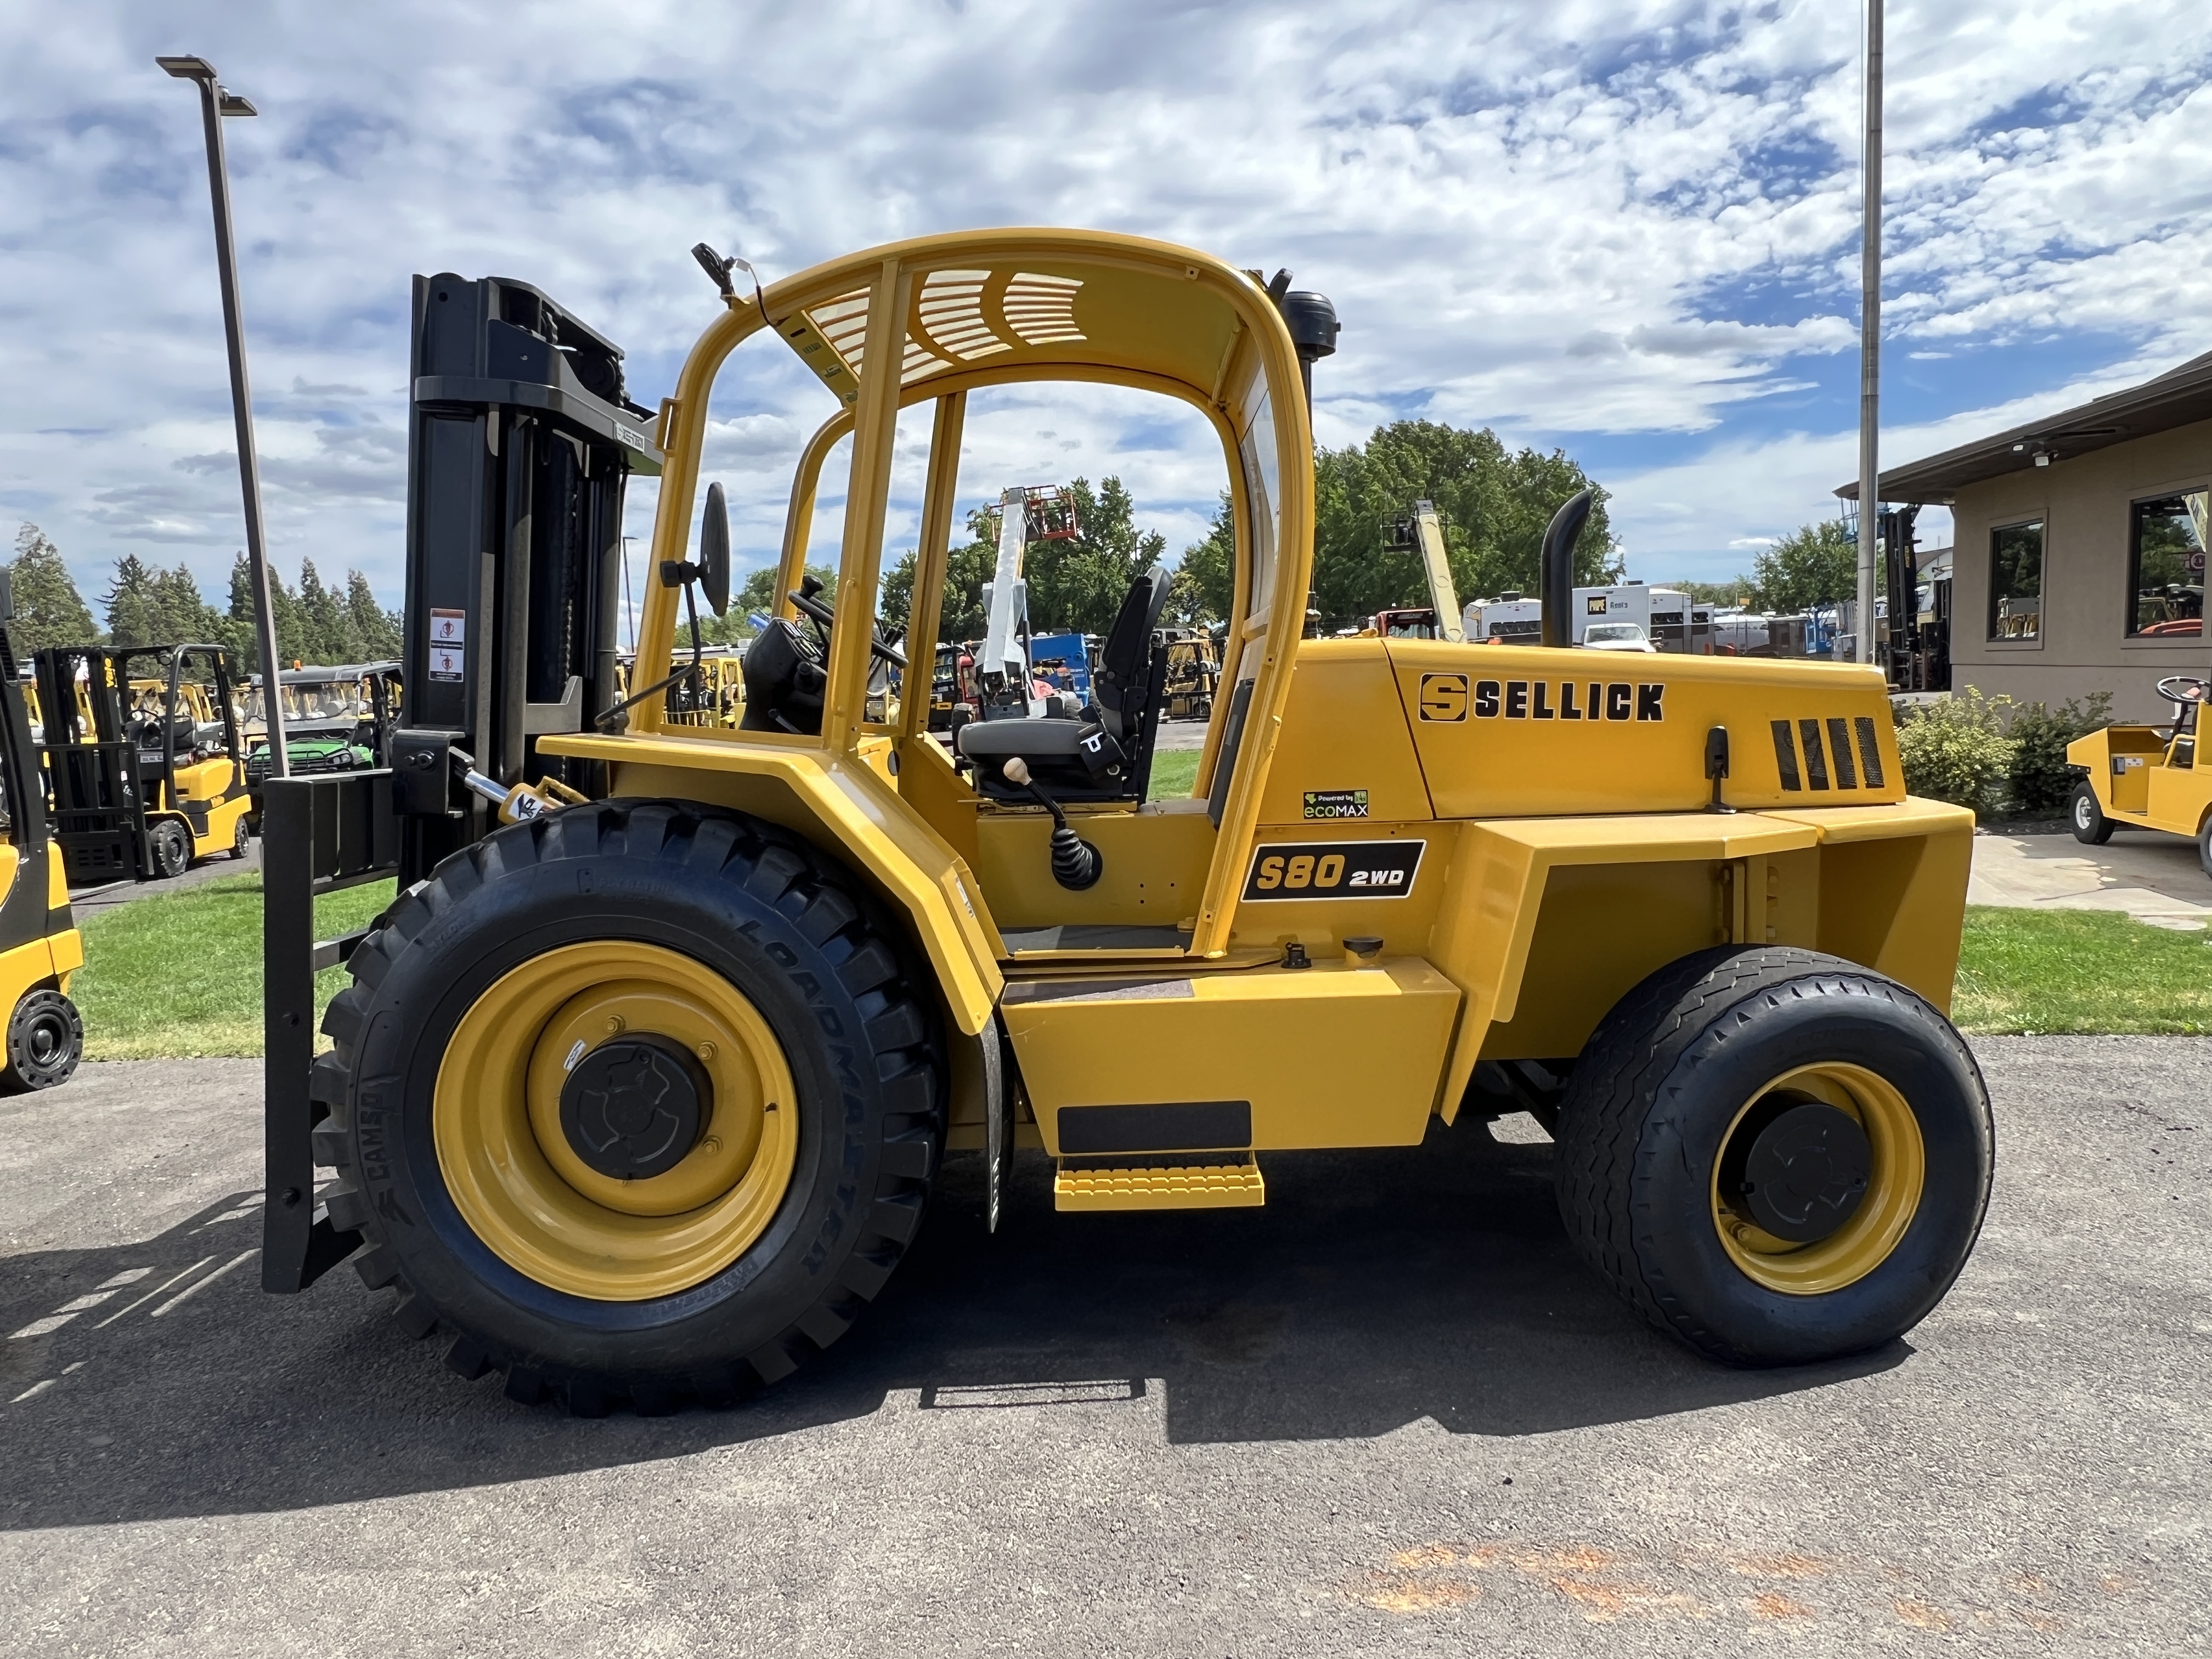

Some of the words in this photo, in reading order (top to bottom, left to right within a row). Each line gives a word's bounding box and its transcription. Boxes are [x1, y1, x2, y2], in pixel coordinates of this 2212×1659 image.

[1475, 680, 1665, 721] SELLICK
[1304, 804, 1368, 818] ecoMAX
[1257, 855, 1345, 889] S80
[1349, 870, 1404, 886] 2WD
[360, 1092, 391, 1181] CAMSO
